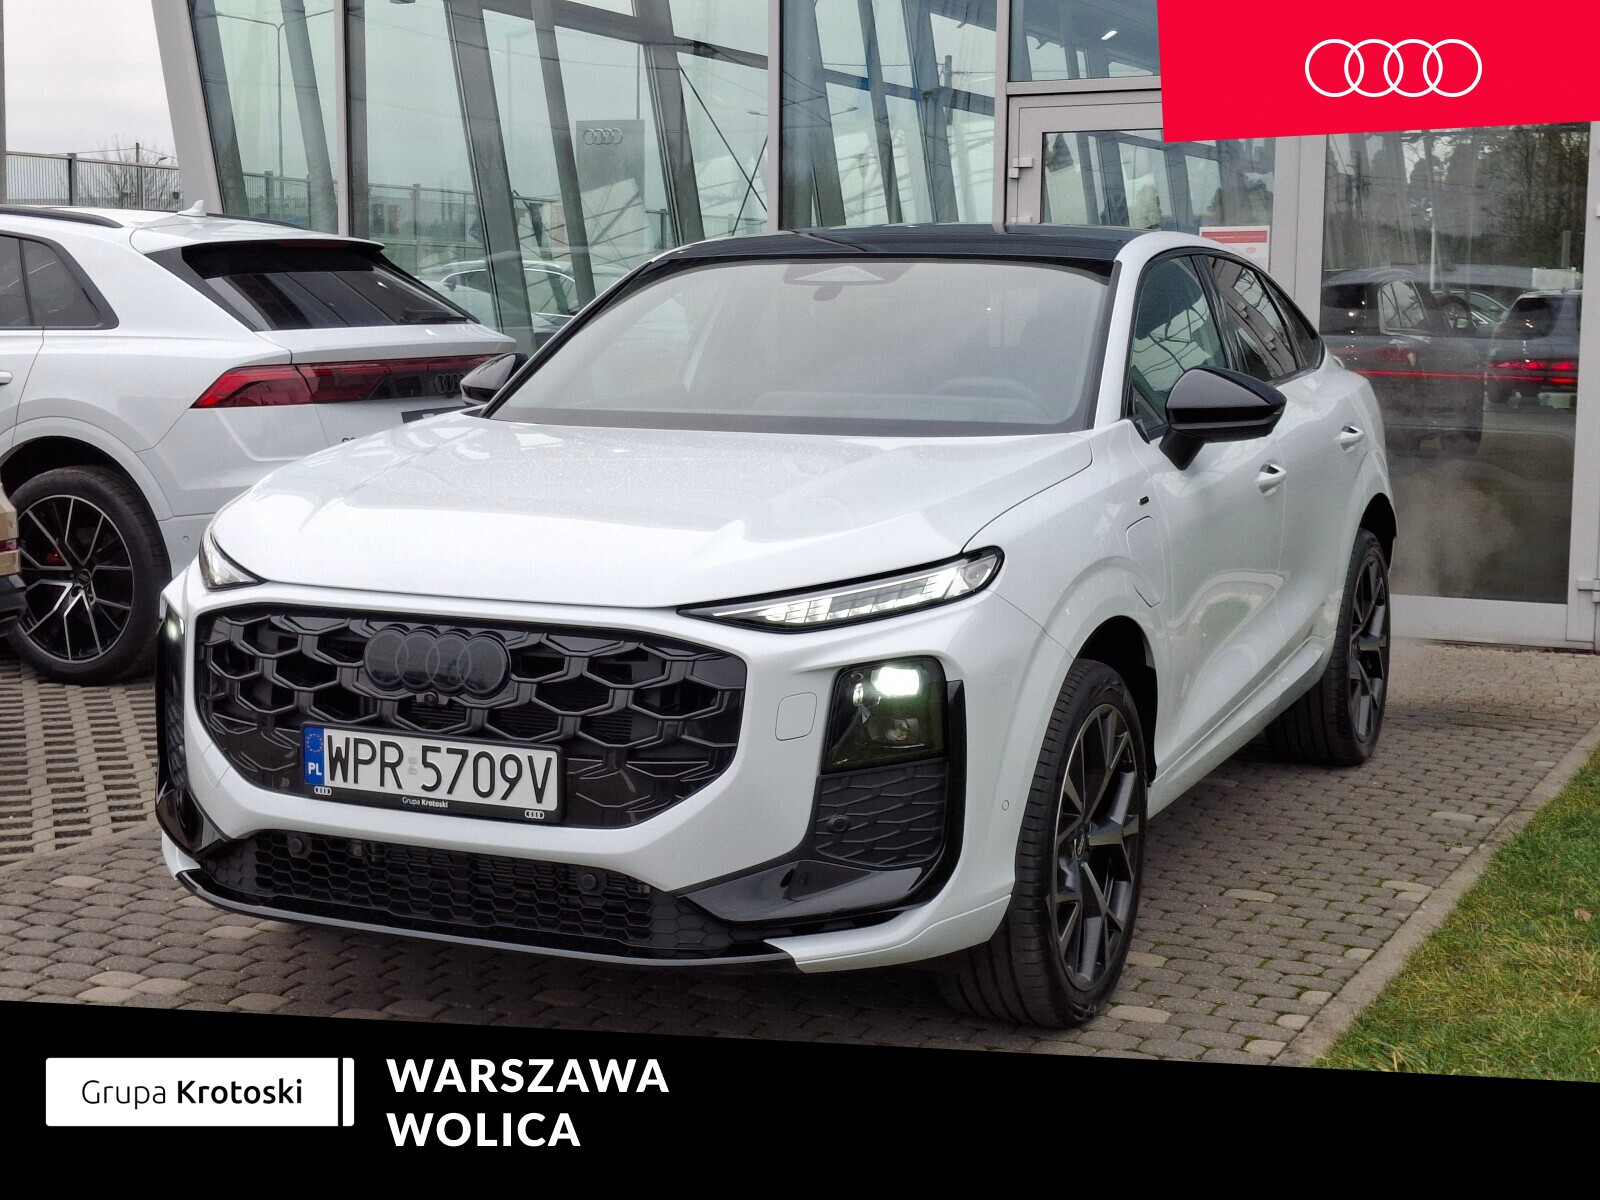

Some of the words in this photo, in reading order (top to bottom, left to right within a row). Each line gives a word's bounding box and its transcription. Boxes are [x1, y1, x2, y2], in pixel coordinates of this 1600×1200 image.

[307, 761, 323, 776] PL
[327, 734, 404, 790] WPR
[420, 744, 553, 804] 5709V
[401, 796, 420, 806] Grupa
[421, 798, 449, 808] Krotoski
